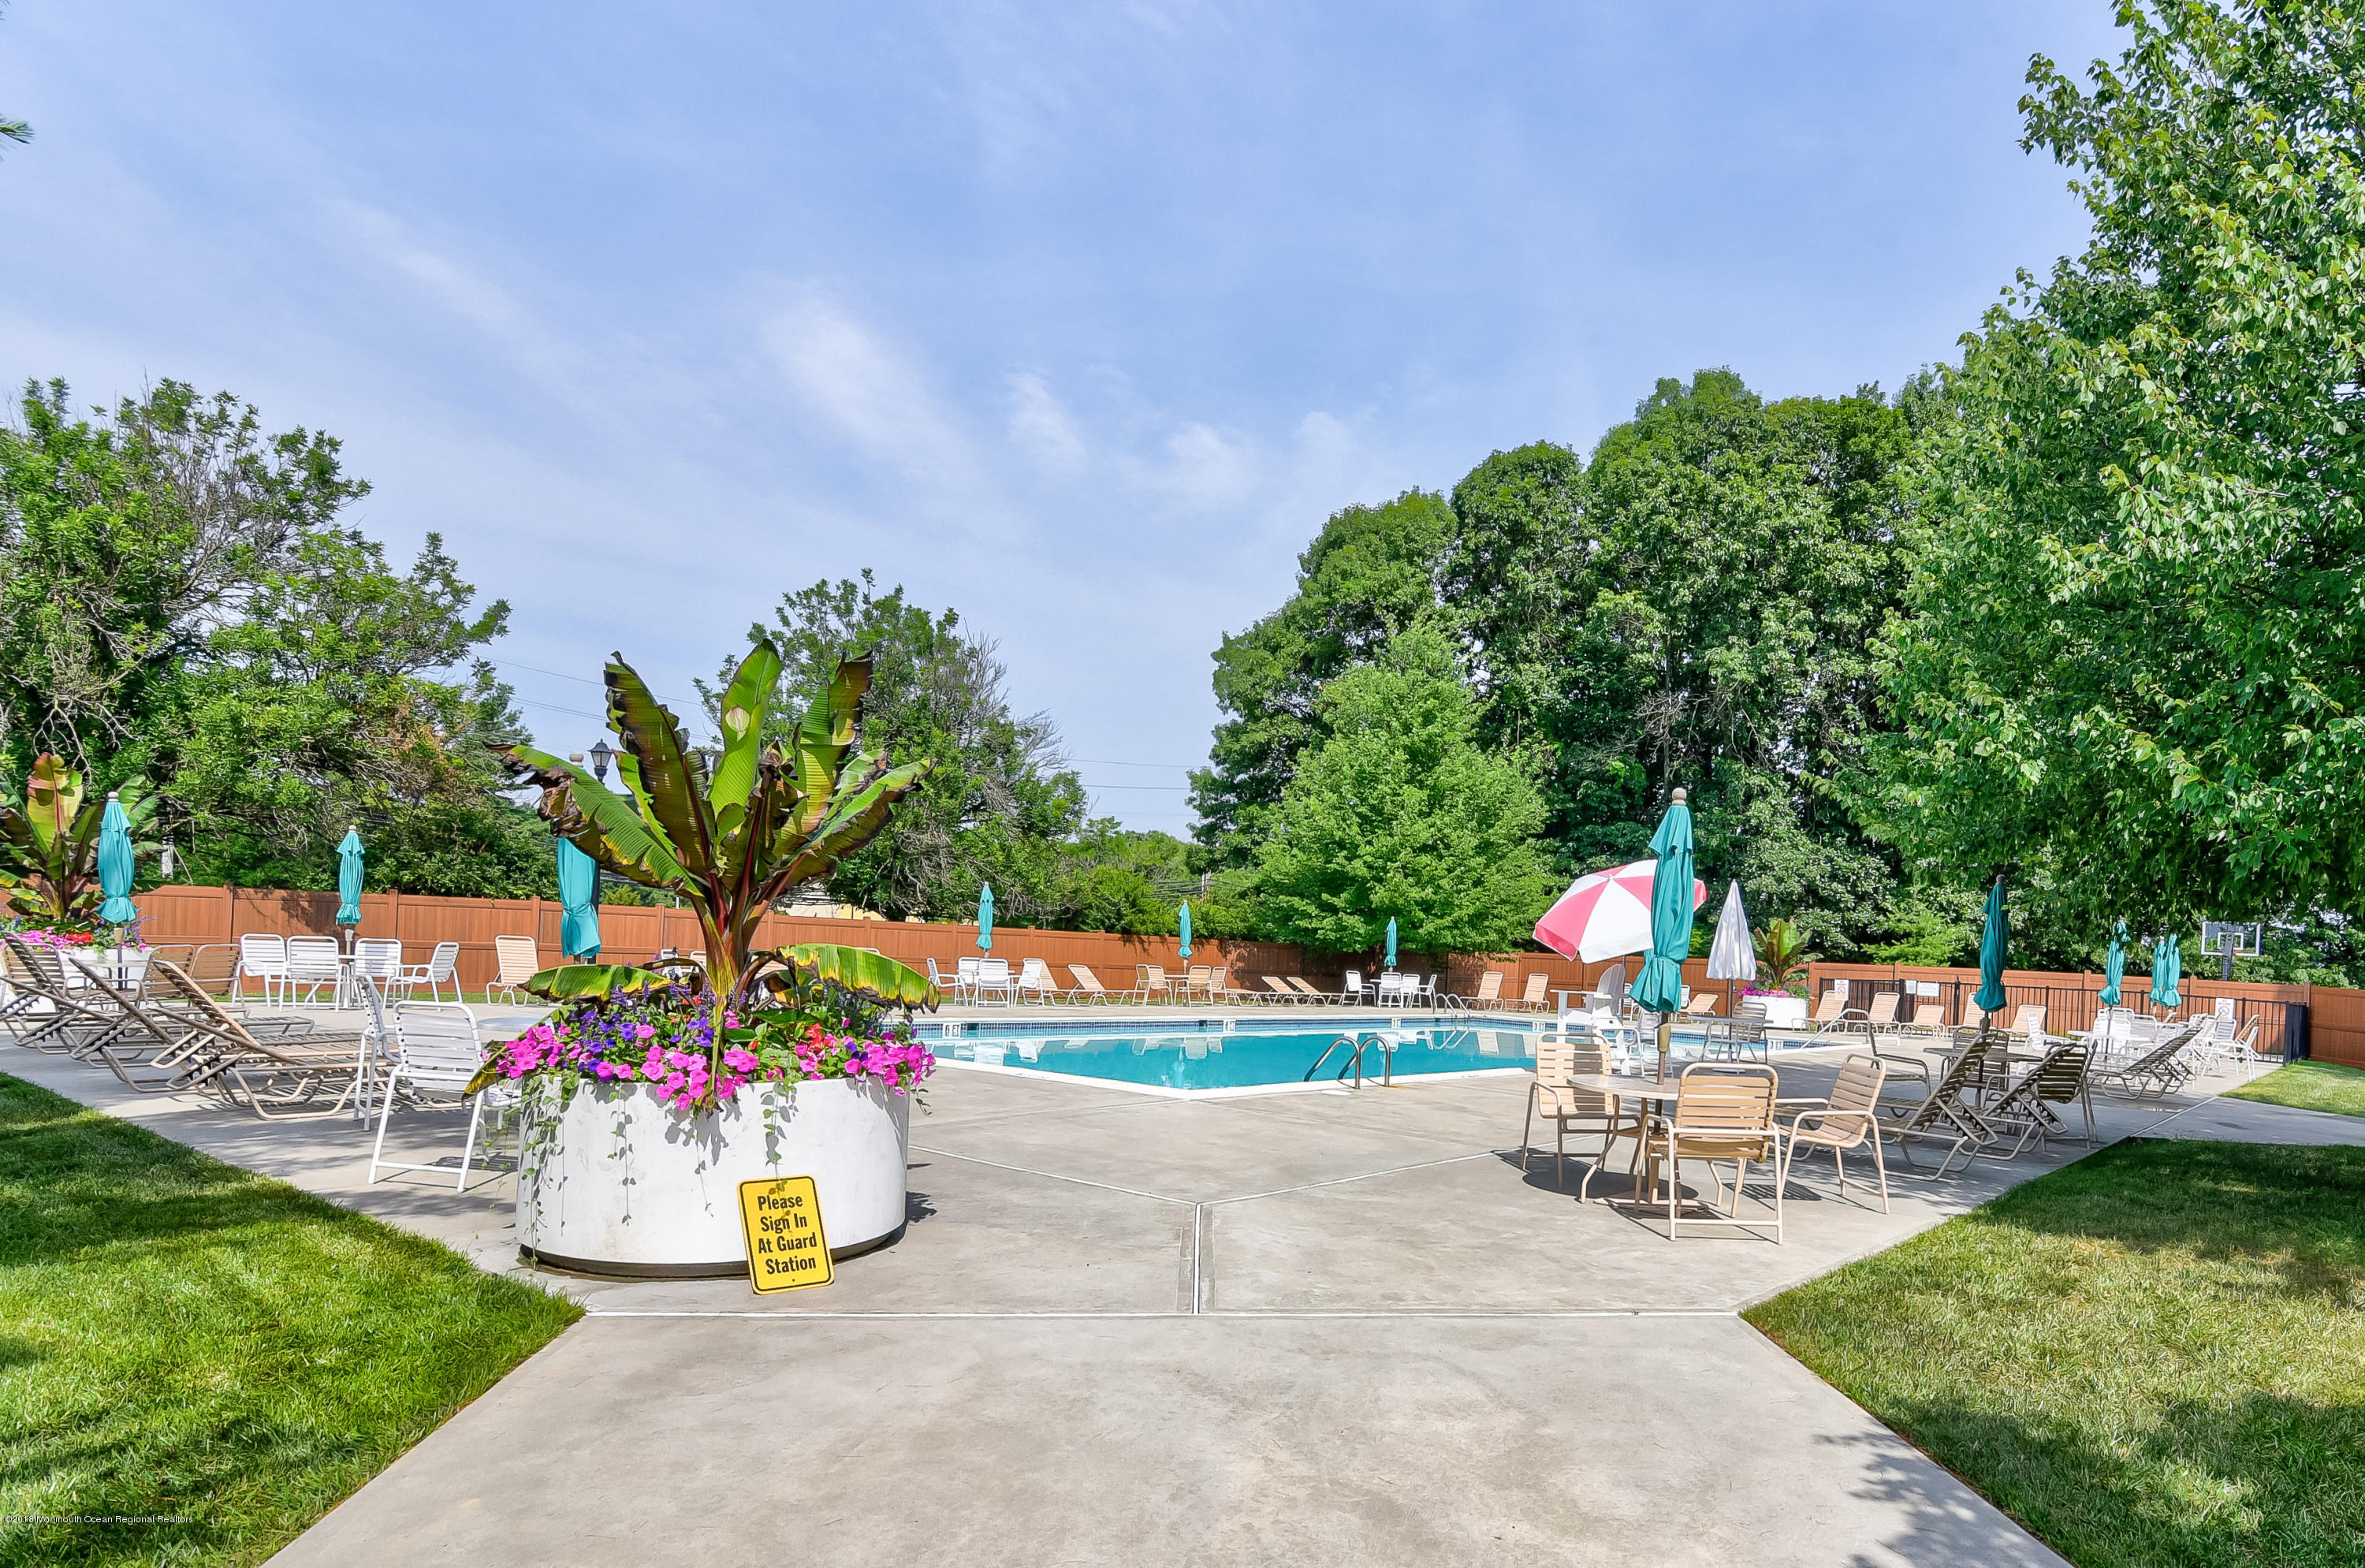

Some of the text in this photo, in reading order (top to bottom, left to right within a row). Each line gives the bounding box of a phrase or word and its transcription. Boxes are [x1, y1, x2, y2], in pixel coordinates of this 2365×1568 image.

[758, 1195, 803, 1211] Please
[760, 1213, 808, 1234] Sign In
[758, 1232, 818, 1254] At Guard
[765, 1255, 817, 1275] Station
